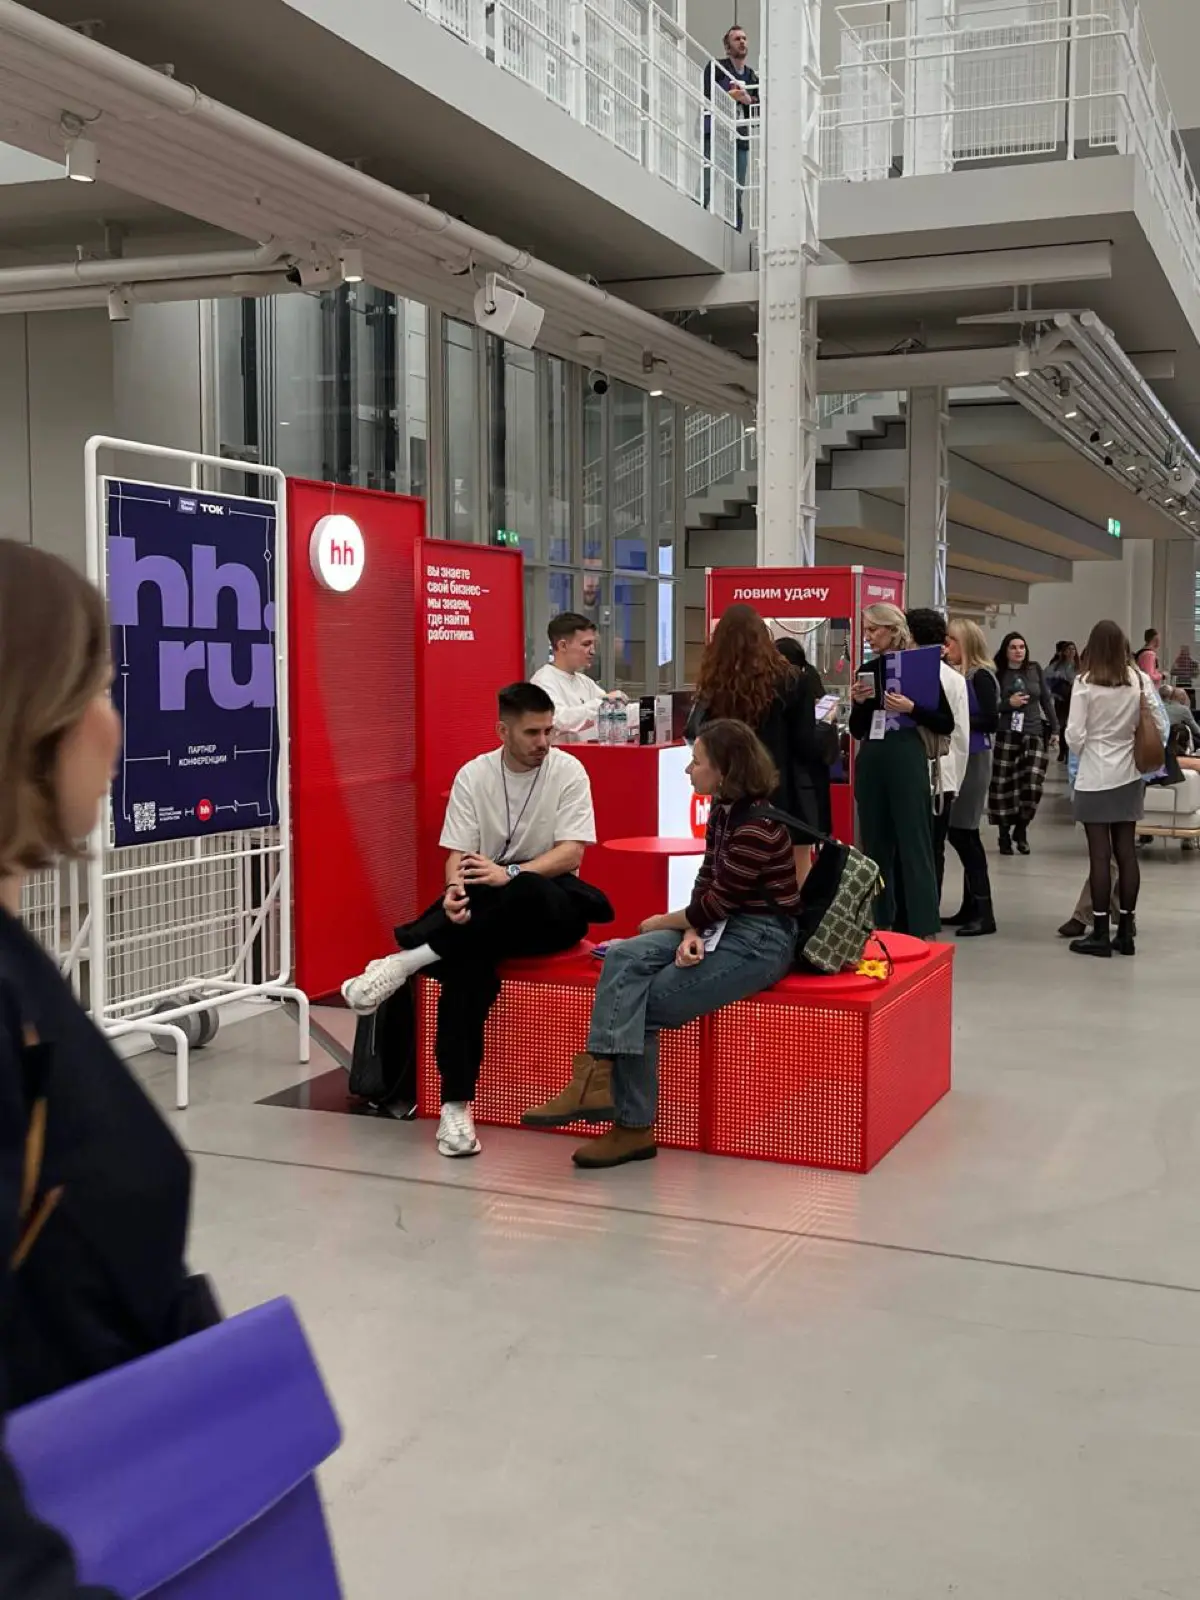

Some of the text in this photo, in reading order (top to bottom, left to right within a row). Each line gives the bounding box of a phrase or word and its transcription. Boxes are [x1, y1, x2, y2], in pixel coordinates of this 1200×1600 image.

[330, 538, 354, 566] hh
[427, 565, 471, 580] вы знаете
[427, 579, 449, 594] свой
[449, 580, 481, 596] бизнес
[733, 587, 830, 602] ловим удачу
[427, 598, 472, 614] мы знаем,
[427, 611, 470, 627] где найти
[427, 626, 475, 645] работника
[158, 640, 275, 711] ru
